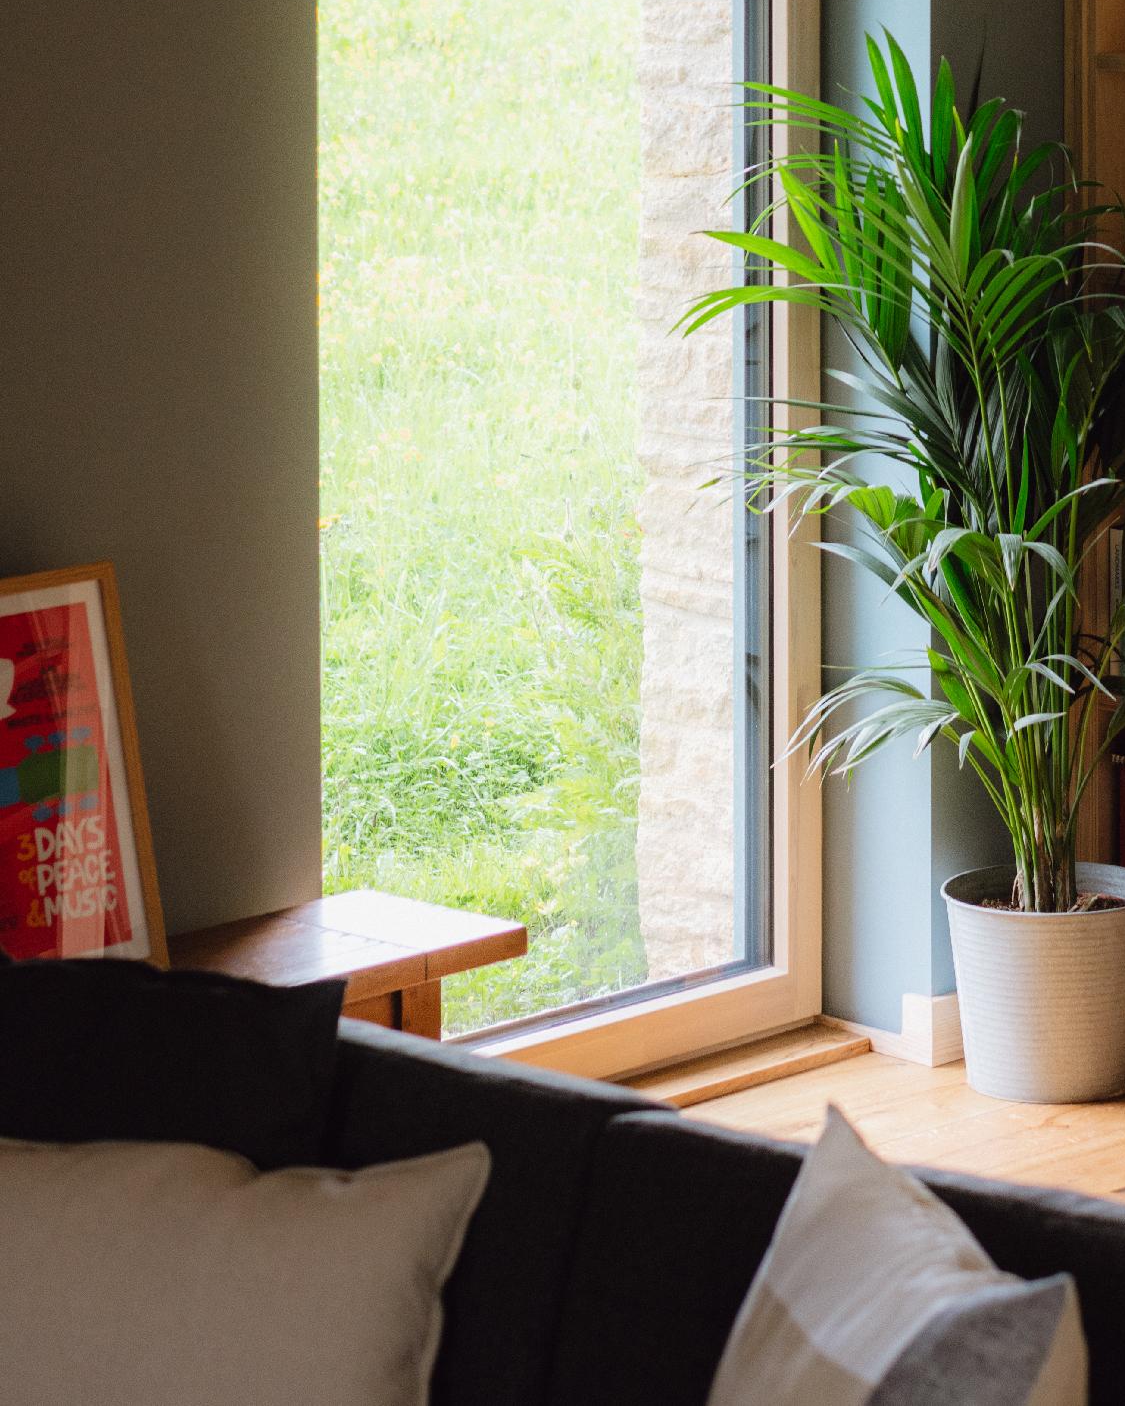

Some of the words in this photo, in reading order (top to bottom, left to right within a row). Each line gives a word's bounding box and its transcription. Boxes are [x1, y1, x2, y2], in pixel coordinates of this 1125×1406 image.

[16, 833, 35, 862] 3
[34, 814, 106, 863] DAYS
[36, 849, 116, 897] PEACE
[25, 898, 49, 929] &
[43, 884, 118, 928] MUSIC
